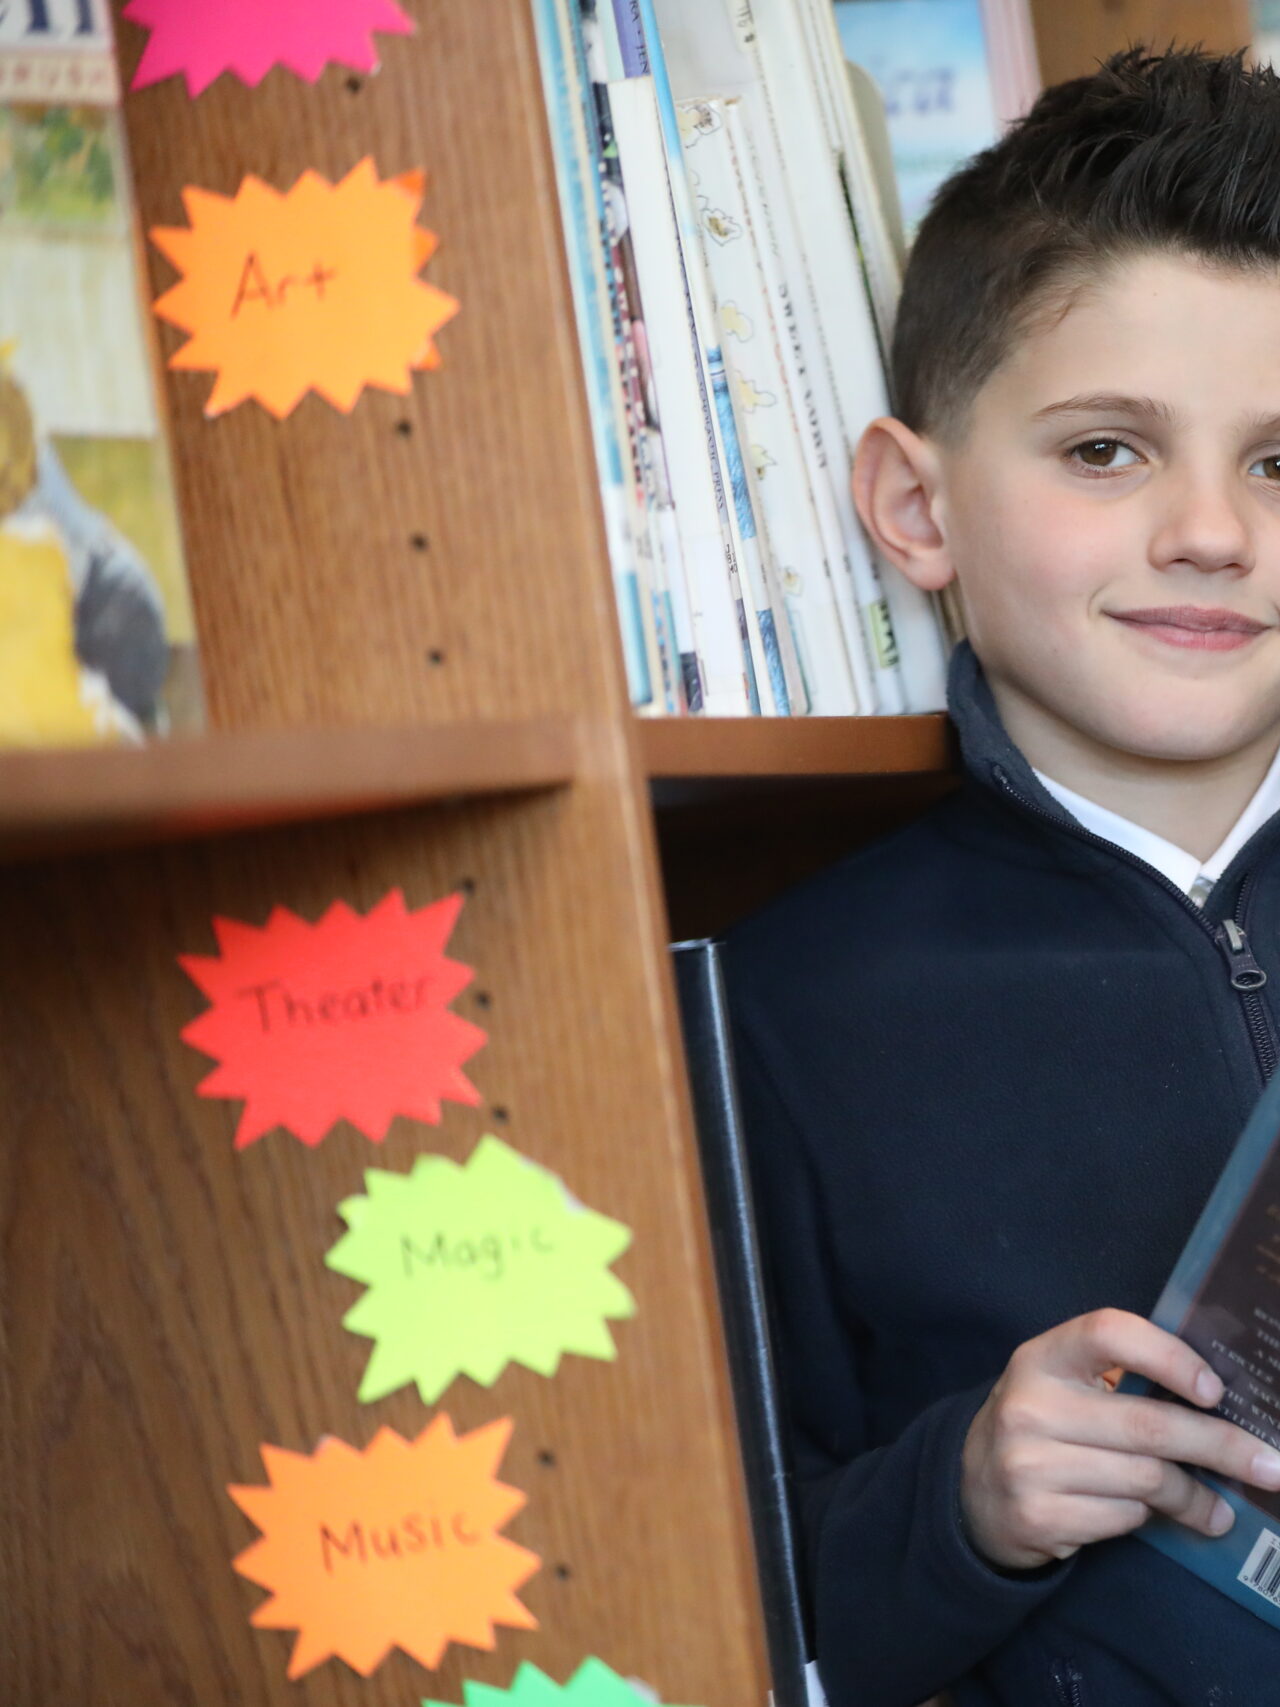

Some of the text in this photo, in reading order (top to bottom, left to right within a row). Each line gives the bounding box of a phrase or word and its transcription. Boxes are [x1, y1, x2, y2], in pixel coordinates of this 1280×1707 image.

[230, 250, 337, 321] Art
[710, 470, 726, 512] PRESS
[238, 977, 433, 1033] Theater
[400, 1228, 554, 1280] Magic
[1210, 1339, 1273, 1384] PERICLES
[318, 1510, 481, 1577] Music
